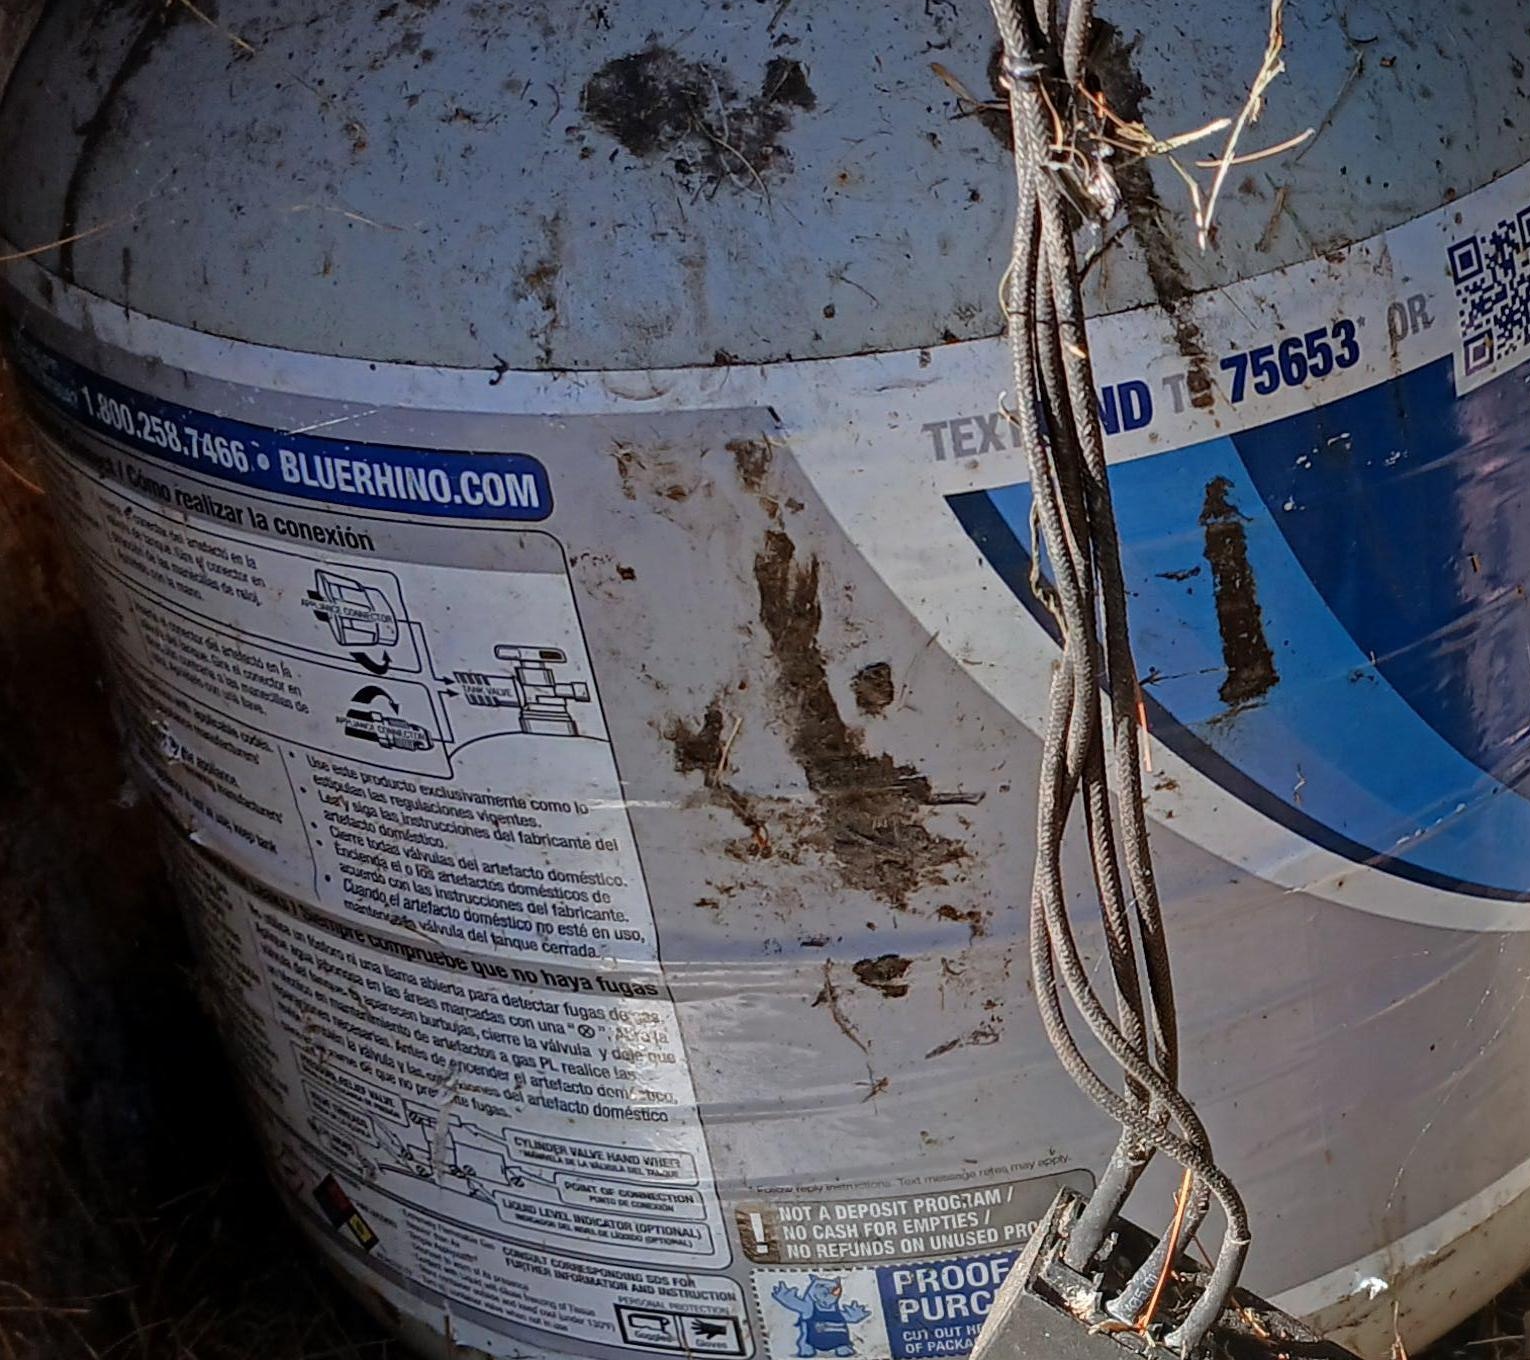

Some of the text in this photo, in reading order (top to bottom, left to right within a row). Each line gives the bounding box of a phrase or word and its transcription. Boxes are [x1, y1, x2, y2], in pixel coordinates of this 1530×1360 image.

[1387, 294, 1434, 341] OR
[82, 386, 539, 508] 1.800.258.7466 BLUERHINO.COM
[176, 490, 244, 524] realizar
[250, 507, 268, 530] la
[274, 519, 375, 551] conexión
[360, 772, 588, 814] producto exclusivamente como lo
[368, 789, 387, 803] las
[390, 795, 474, 819] regulaciones
[478, 809, 541, 828] vigentes.
[353, 802, 618, 852] siga las instrucciones fabricante del
[403, 846, 455, 868] válvulas
[458, 857, 479, 871] del
[482, 861, 544, 880] artefacto
[548, 870, 628, 888] doméstico.
[389, 878, 629, 923] con las instrucciones del fabricante.
[438, 872, 505, 892] artefactos
[508, 882, 589, 903] domésticos
[593, 891, 611, 903] de
[343, 878, 645, 943] Cuando el artefacto doméstico no esté en uso,
[418, 919, 464, 940] válvula
[468, 930, 487, 943] del
[491, 933, 537, 952] tanque
[368, 933, 659, 997] compruebe que no haya fugas
[383, 982, 565, 1035] las áreas marcadas con una
[384, 964, 417, 985] llama
[420, 975, 465, 998] abierta
[469, 987, 499, 1004] para
[502, 992, 559, 1015] detectar
[564, 1002, 605, 1021] fugas
[433, 1034, 496, 1059] artefactos
[500, 1050, 508, 1062] a
[512, 1054, 535, 1069] gas
[540, 1057, 559, 1072] PL
[561, 1062, 610, 1080] realice
[614, 1067, 636, 1081] las
[482, 1026, 521, 1045] cierre
[523, 1034, 538, 1049] la
[541, 1038, 592, 1058] válvula
[599, 1047, 607, 1061] y
[431, 1053, 446, 1066] de
[449, 1060, 510, 1081] encender
[531, 1073, 593, 1095] artefacto
[504, 1089, 669, 1122] del artefacto doméstico
[514, 1137, 640, 1166] CYLINDER VALVE HAND
[899, 1175, 922, 1186] Text
[925, 1169, 976, 1184] message
[1011, 1159, 1036, 1174] may
[1038, 1152, 1072, 1169] apply.
[564, 1181, 694, 1204] POINT OF CONNECTION
[778, 1204, 813, 1222] NOT
[819, 1202, 832, 1220] A
[835, 1200, 908, 1220] DEPOSIT
[502, 1199, 702, 1240] LIQUID LEVEL INDICATOR (OPTIONAL)
[782, 1211, 979, 1241] NO CASH FOR EMPTIES
[787, 1219, 1043, 1258] NO REFUNDS ON UNUSED PRO
[503, 1246, 548, 1266] CONSULT
[551, 1255, 643, 1283] CORRESPONDING
[672, 1277, 696, 1288] FOR
[506, 1258, 737, 1302] FURTHER INFORMATION AND INSTRUCTION
[893, 1258, 1009, 1295] PROOF
[618, 1295, 730, 1314] PERSONAL PROTECTION
[898, 1289, 1001, 1323] PURC
[695, 1339, 728, 1349] Gloves
[905, 1338, 976, 1354] OF PACKA
[935, 1327, 961, 1338] OUT
